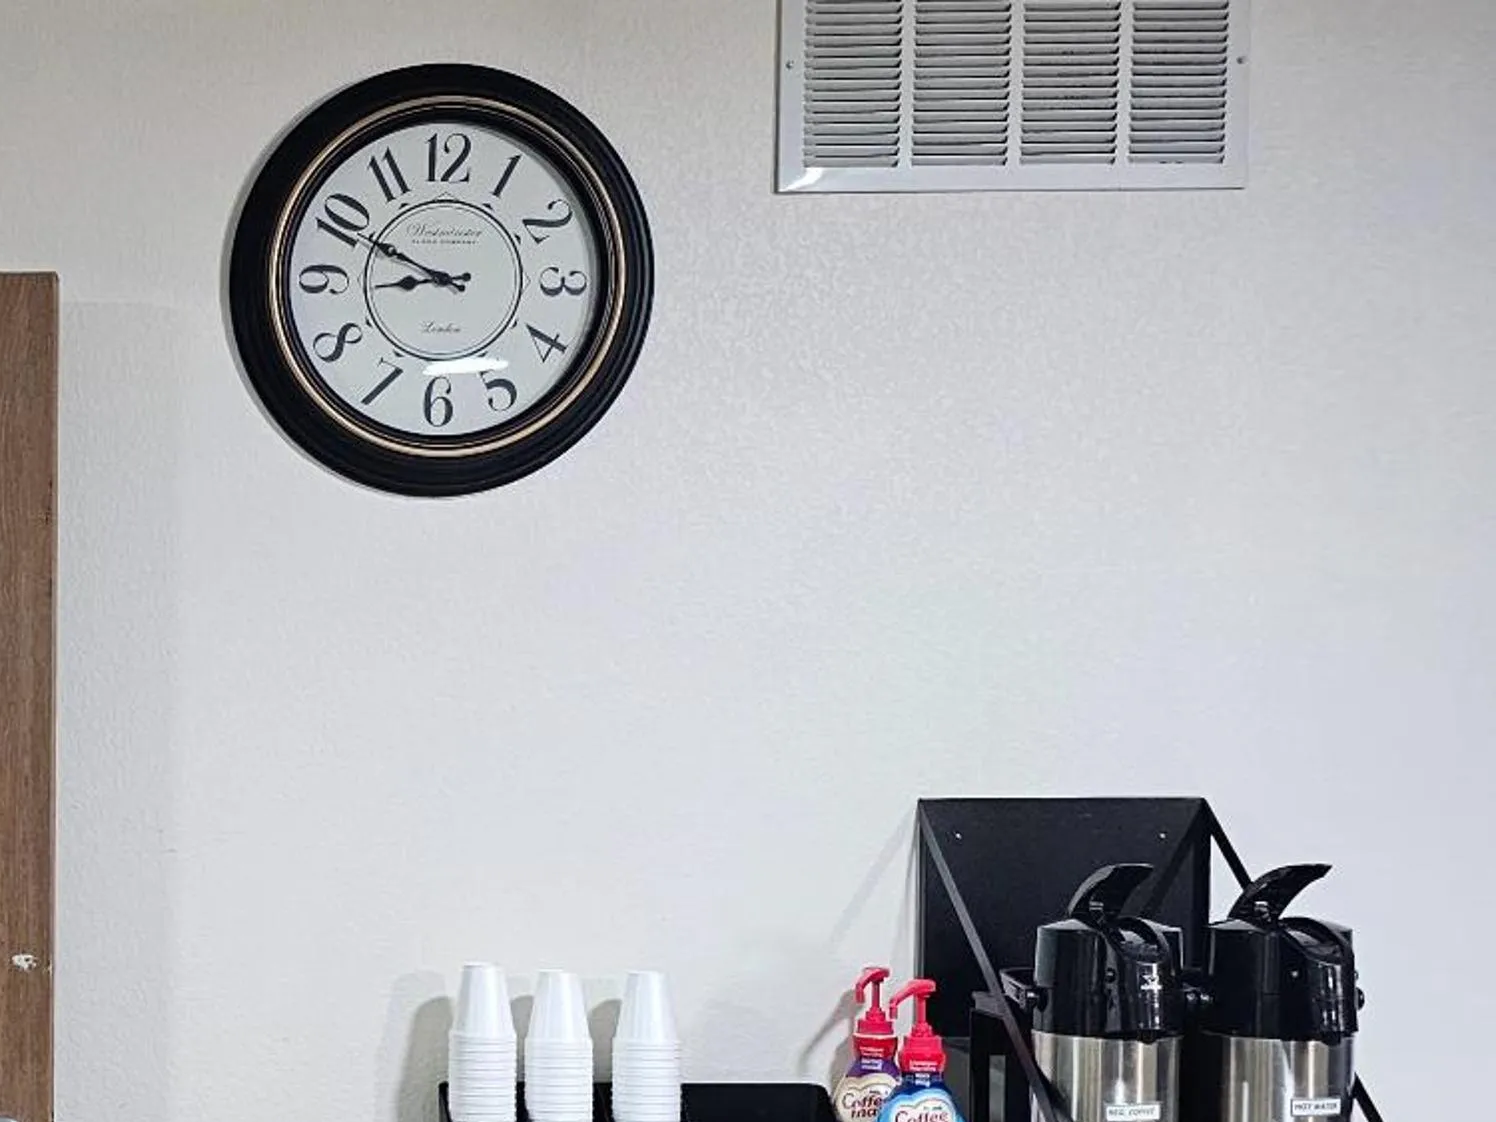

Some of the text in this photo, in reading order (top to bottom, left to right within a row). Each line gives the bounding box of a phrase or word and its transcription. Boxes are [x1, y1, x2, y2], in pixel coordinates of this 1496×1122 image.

[367, 146, 411, 202] 11
[423, 133, 472, 184] 12
[491, 153, 523, 198] 1
[315, 192, 371, 248] 10
[521, 199, 574, 245] 2
[298, 263, 350, 295] 9
[539, 266, 588, 298] 3
[312, 322, 363, 363] 8
[526, 323, 567, 364] 4
[360, 357, 404, 406] 7
[423, 376, 454, 427] 6
[477, 368, 518, 411] 5
[842, 1092, 884, 1109] Coffe
